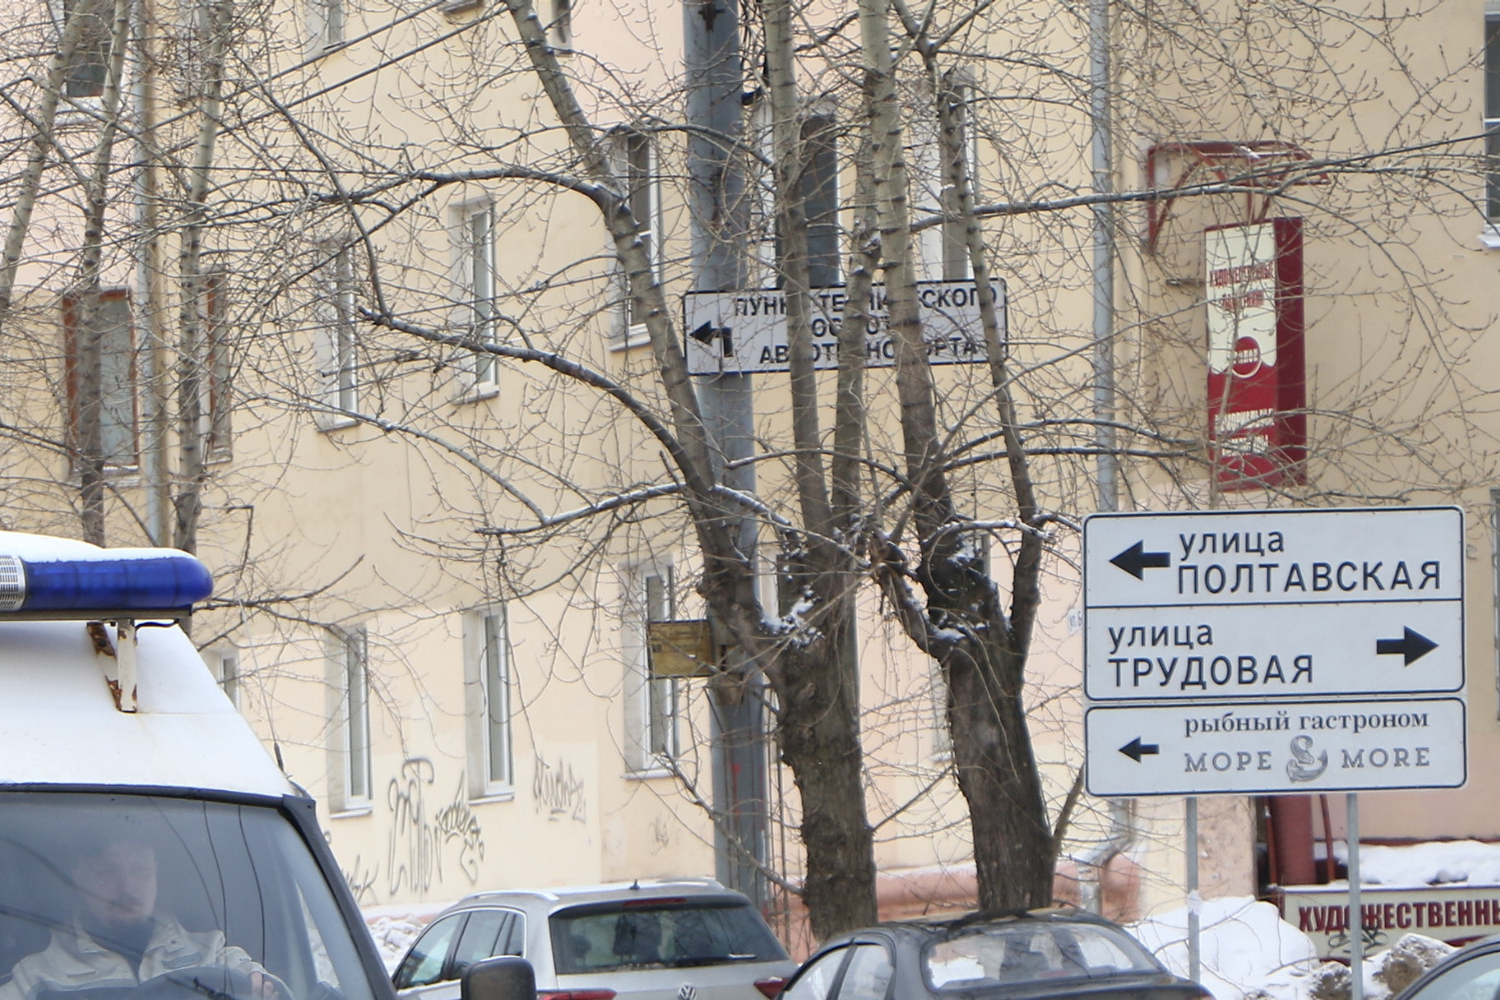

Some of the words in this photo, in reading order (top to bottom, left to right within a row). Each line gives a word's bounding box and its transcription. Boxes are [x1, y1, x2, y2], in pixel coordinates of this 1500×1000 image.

[1179, 531, 1284, 562] улица
[1178, 560, 1441, 594] ПОЛТАВСКАЯ
[1108, 624, 1214, 655] улица
[1108, 655, 1314, 690] ТРУДОВАЯ
[1184, 711, 1290, 737] рыбный
[1298, 712, 1429, 733] гастроном
[1184, 751, 1272, 773] МОРЕ
[1342, 747, 1431, 769] MORE
